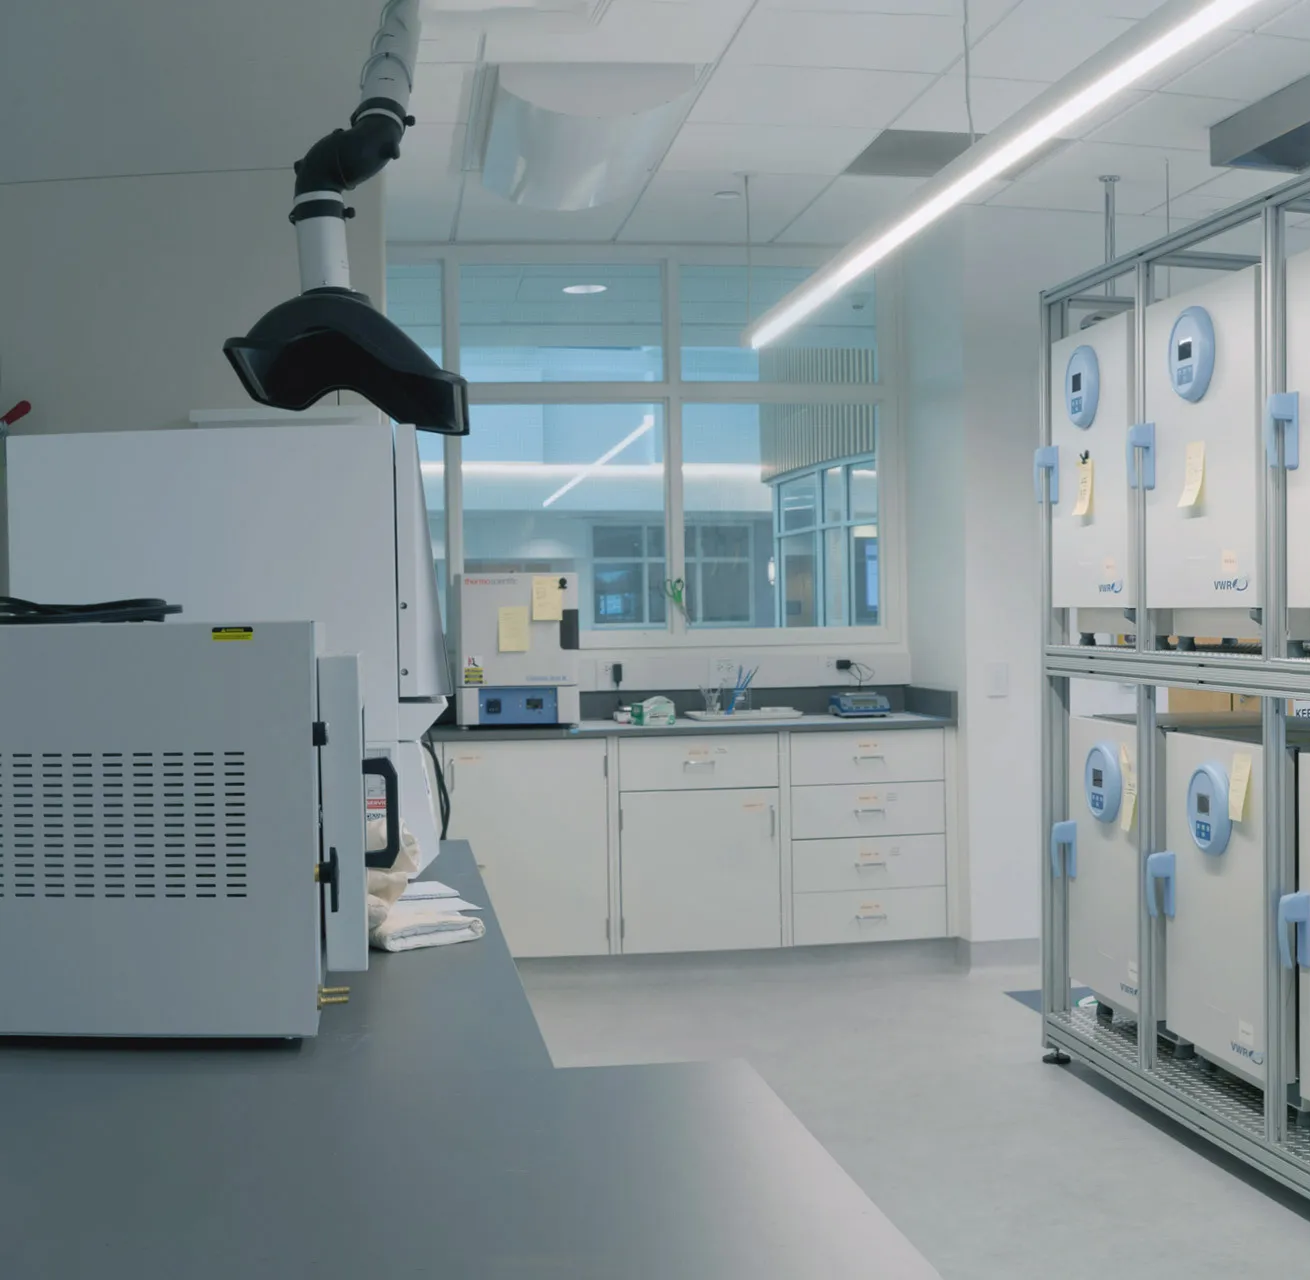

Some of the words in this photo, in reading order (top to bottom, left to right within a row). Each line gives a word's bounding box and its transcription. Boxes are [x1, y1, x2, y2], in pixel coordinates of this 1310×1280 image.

[1098, 583, 1112, 592] VWR
[1213, 580, 1233, 590] VWR
[1231, 1040, 1249, 1058] VWR
